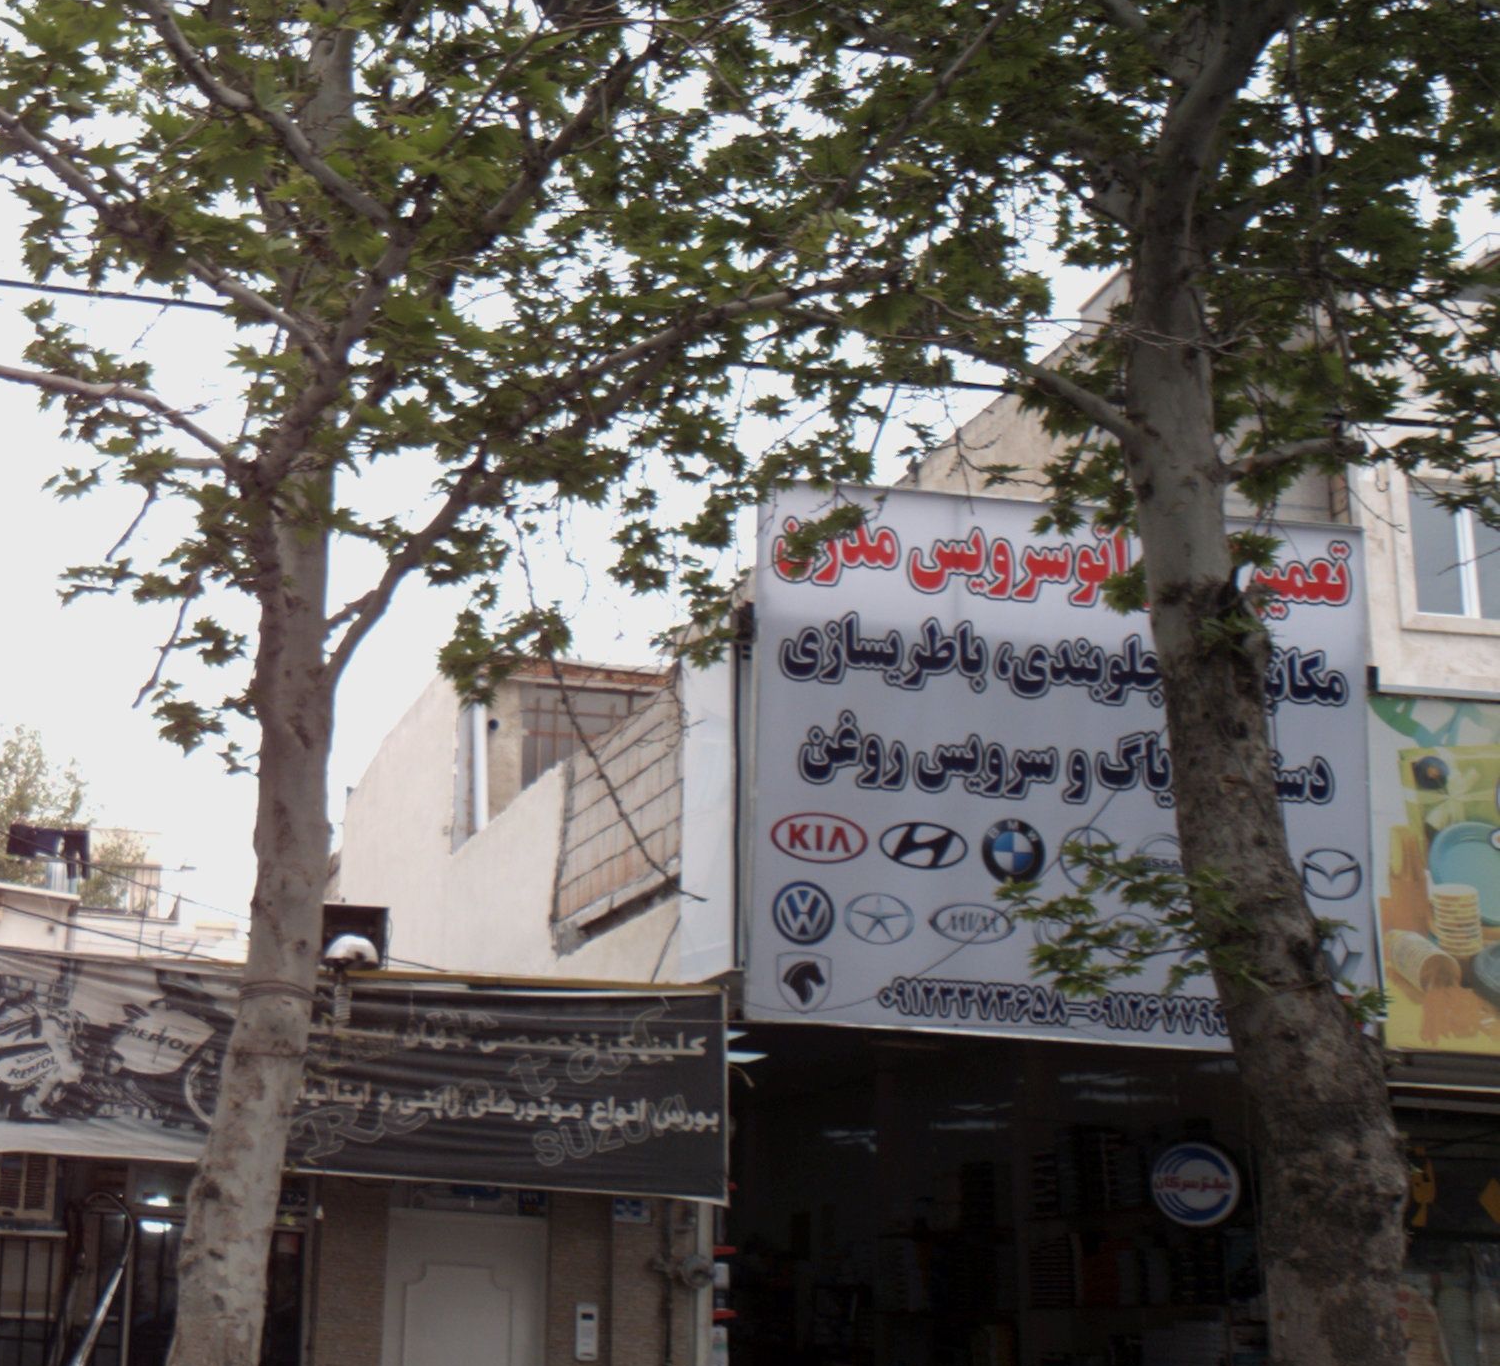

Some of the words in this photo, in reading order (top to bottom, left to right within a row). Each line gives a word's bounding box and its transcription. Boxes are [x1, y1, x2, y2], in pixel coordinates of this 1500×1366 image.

[799, 710, 909, 793] روغن
[912, 735, 1061, 800] سرویس
[1063, 746, 1092, 803] و
[787, 822, 853, 854] KIA
[378, 1091, 391, 1112] و
[588, 1096, 647, 1132] انواع
[653, 1108, 720, 1134] بورس
